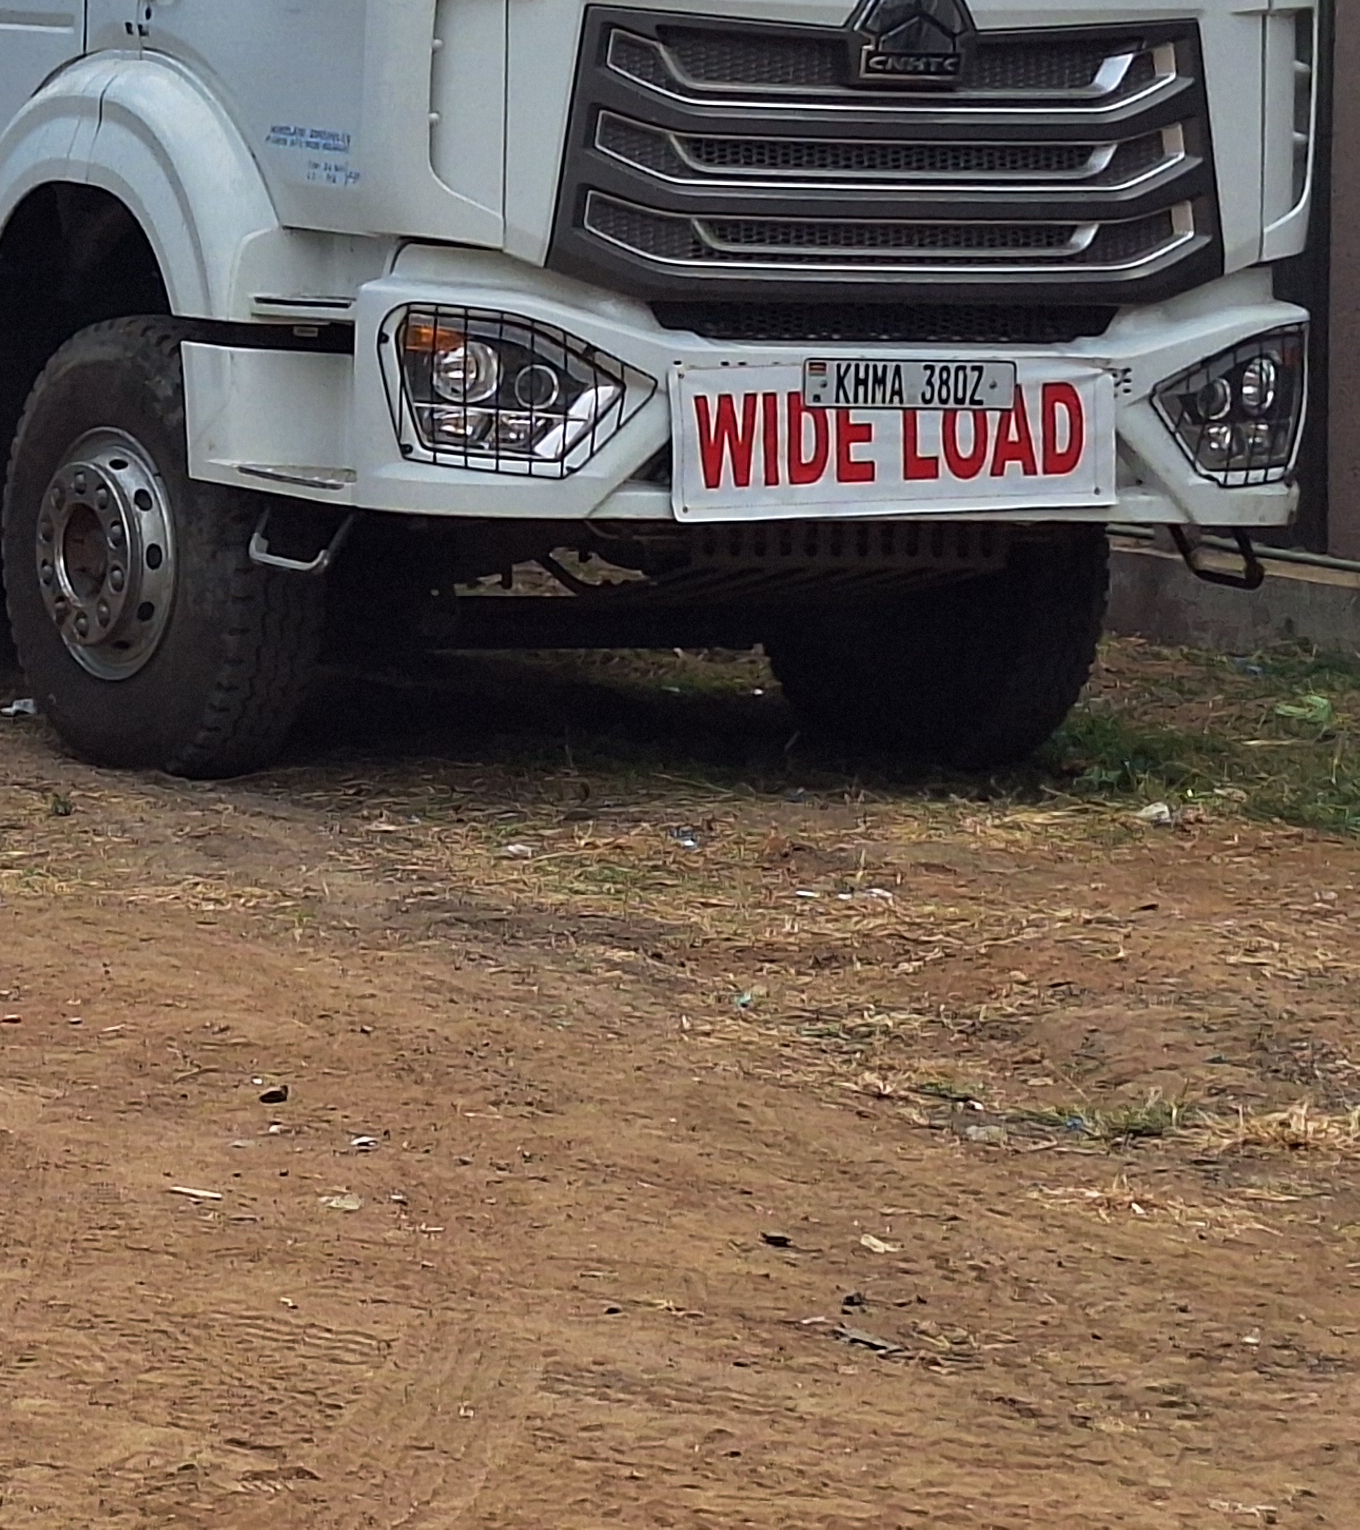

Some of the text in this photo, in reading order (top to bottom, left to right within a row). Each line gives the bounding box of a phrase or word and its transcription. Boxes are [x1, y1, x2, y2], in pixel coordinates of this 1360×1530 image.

[868, 55, 959, 72] CNHTC
[835, 362, 985, 406] KHMA 380Z
[694, 381, 1082, 489] WIDE LOAD
